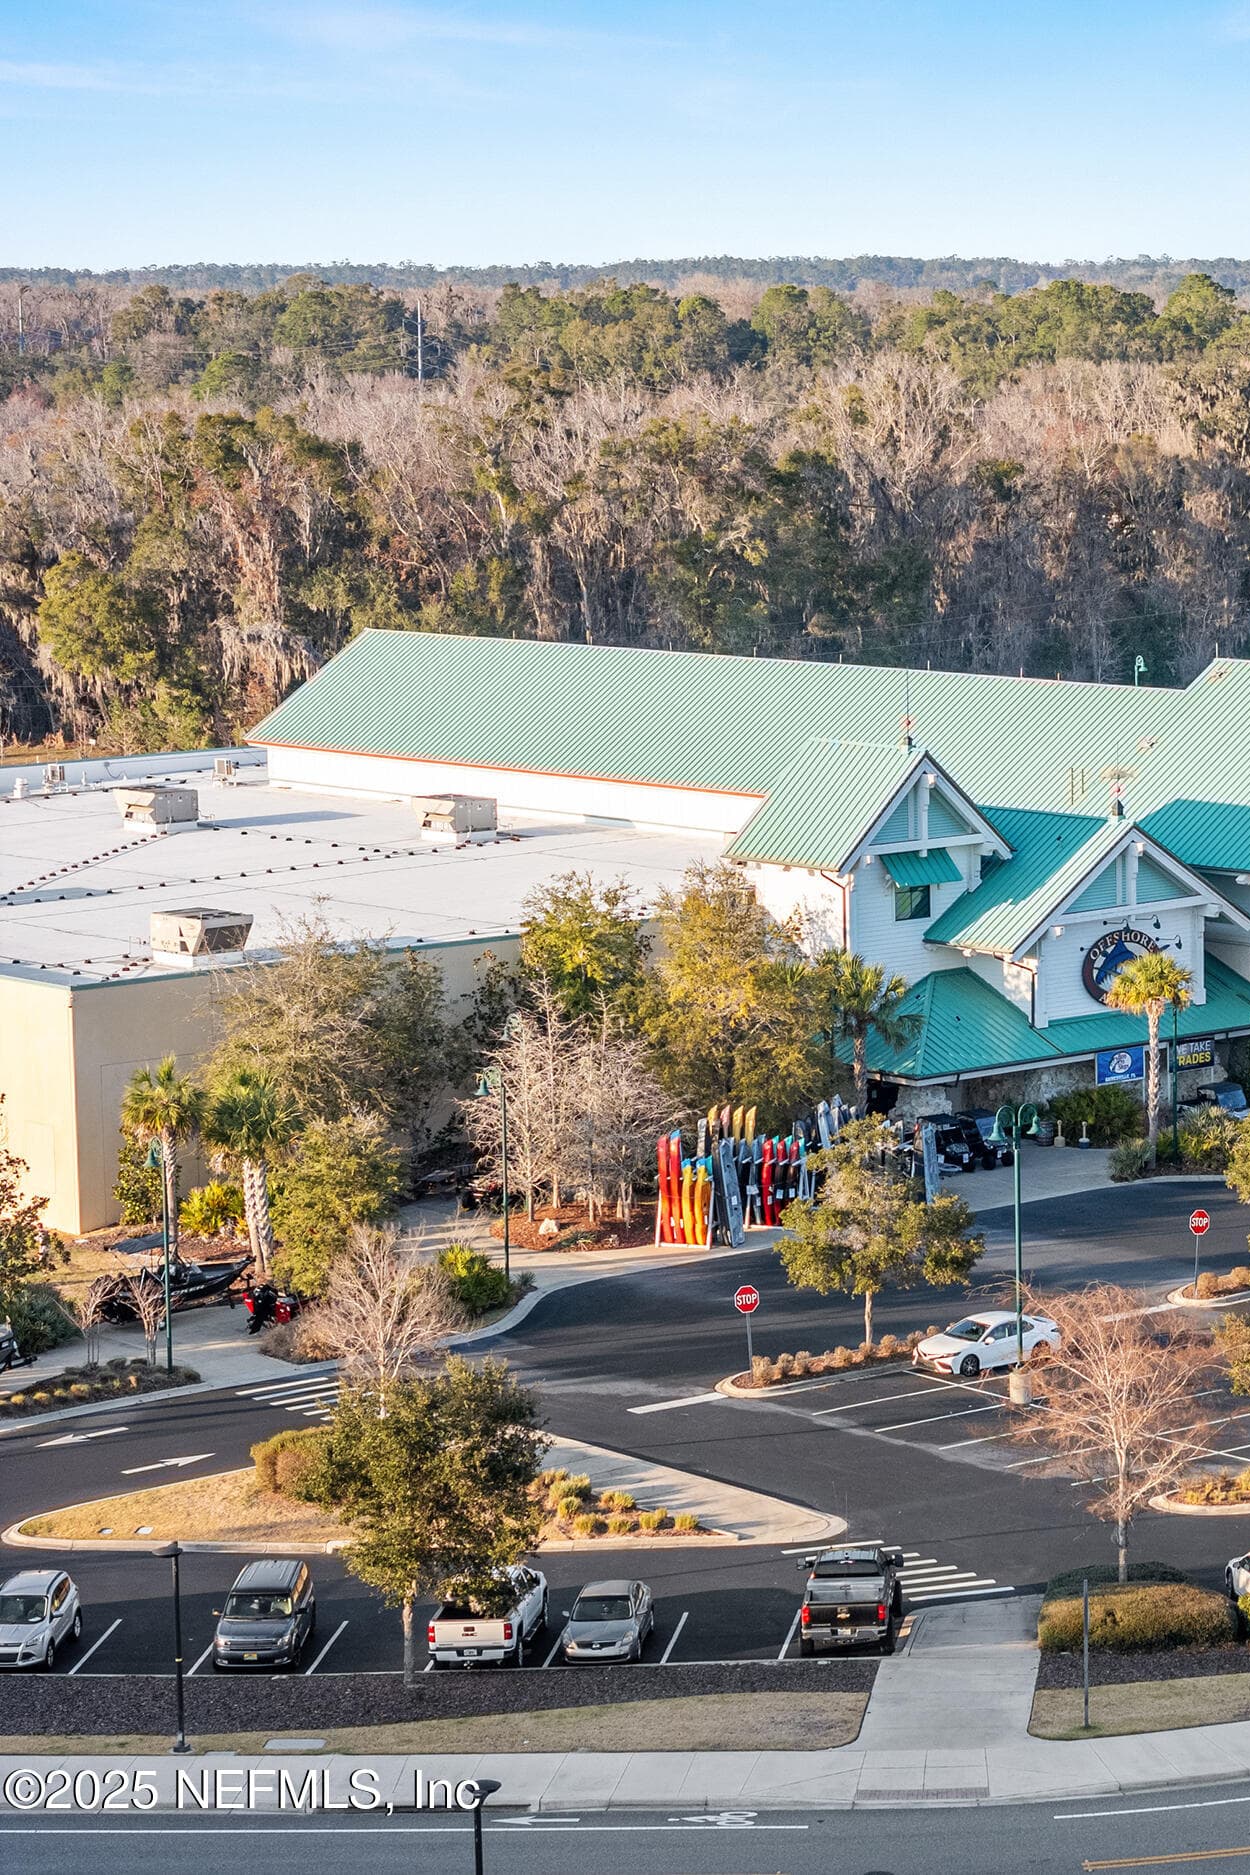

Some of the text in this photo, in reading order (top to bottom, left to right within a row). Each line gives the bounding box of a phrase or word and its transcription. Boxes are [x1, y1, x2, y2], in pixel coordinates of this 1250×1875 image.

[1090, 931, 1156, 960] OFFSHORE
[1190, 1040, 1211, 1053] TAKE
[1191, 1217, 1208, 1227] STOP
[736, 1293, 757, 1306] STOP
